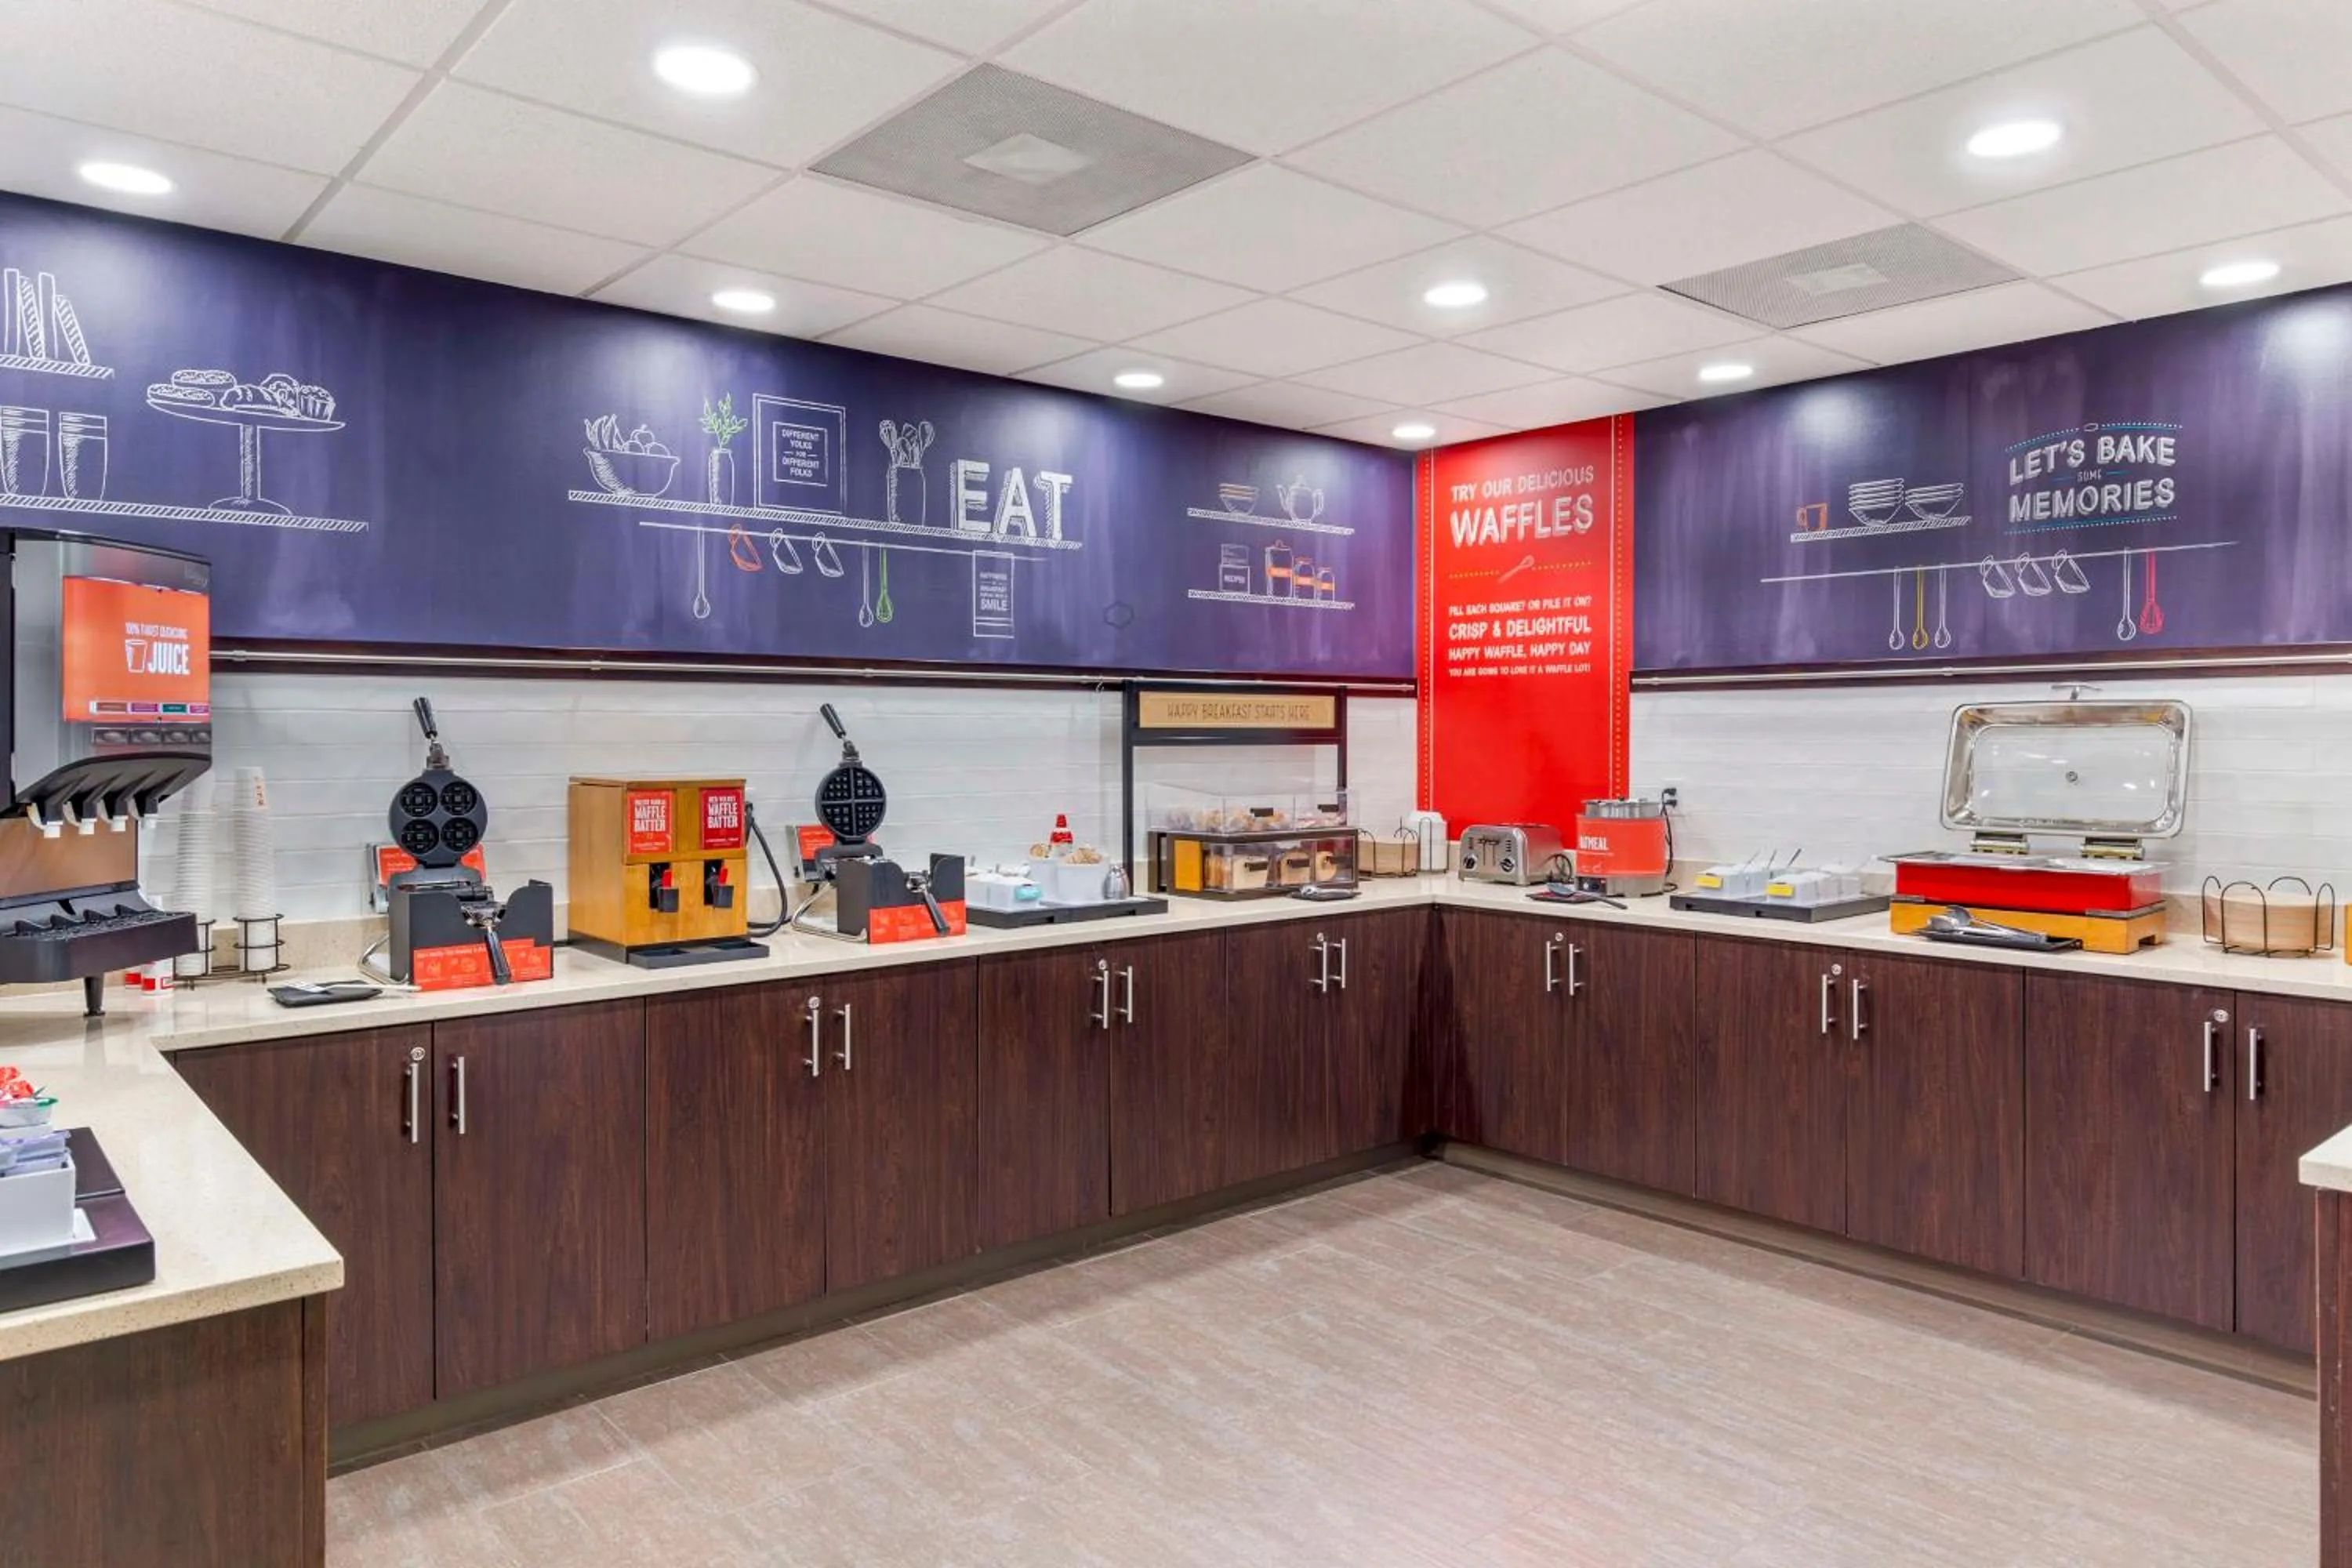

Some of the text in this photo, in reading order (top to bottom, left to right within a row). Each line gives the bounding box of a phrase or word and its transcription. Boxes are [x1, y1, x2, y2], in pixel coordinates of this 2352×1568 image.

[2009, 434, 2176, 486] LET'S BAKE
[1450, 465, 1594, 503] TRY OUR DELICIOUS
[2078, 469, 2102, 482] SOME
[950, 459, 1073, 540] EAT
[2009, 477, 2176, 523] MEMORIES
[1450, 492, 1594, 549] WAFFLES
[981, 598, 1010, 611] SMILE
[1466, 603, 1486, 616] EACH
[1528, 599, 1540, 611] OR
[1543, 597, 1560, 609] PILE
[1563, 597, 1572, 608] IT
[1449, 615, 1592, 641] CRISP & DELIGHTFUL
[147, 641, 190, 675] JUICE
[1449, 647, 1480, 661] HAPPY
[1530, 642, 1566, 658] HAPPY
[1570, 641, 1592, 656] DAY
[1545, 664, 1572, 674] WAFFLE
[1167, 702, 1310, 722] HAPPY BREAKFAST STARTS HERE
[633, 805, 666, 819] WAFFLE
[708, 802, 738, 815] WAFFLE
[633, 818, 666, 832] BATTER
[708, 815, 738, 829] BATTER
